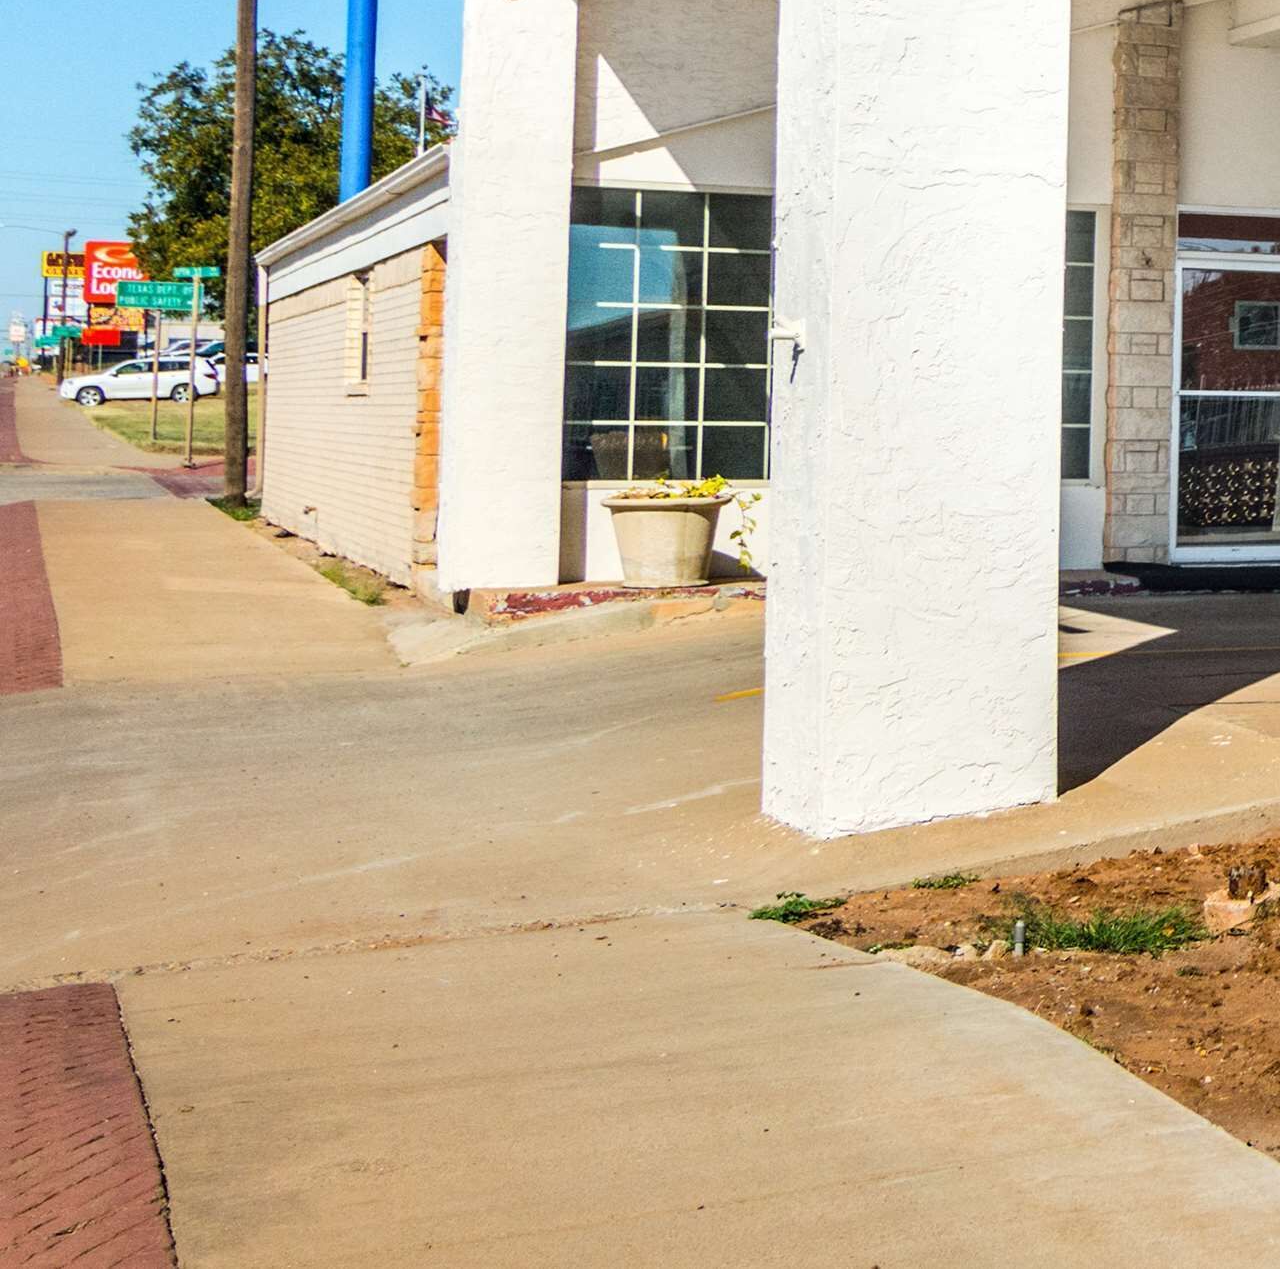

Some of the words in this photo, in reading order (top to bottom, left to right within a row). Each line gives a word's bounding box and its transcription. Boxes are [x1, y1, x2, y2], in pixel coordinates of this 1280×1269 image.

[127, 284, 154, 294] TEXAS
[119, 296, 149, 306] PUBLIC
[152, 297, 182, 307] SAFETY
